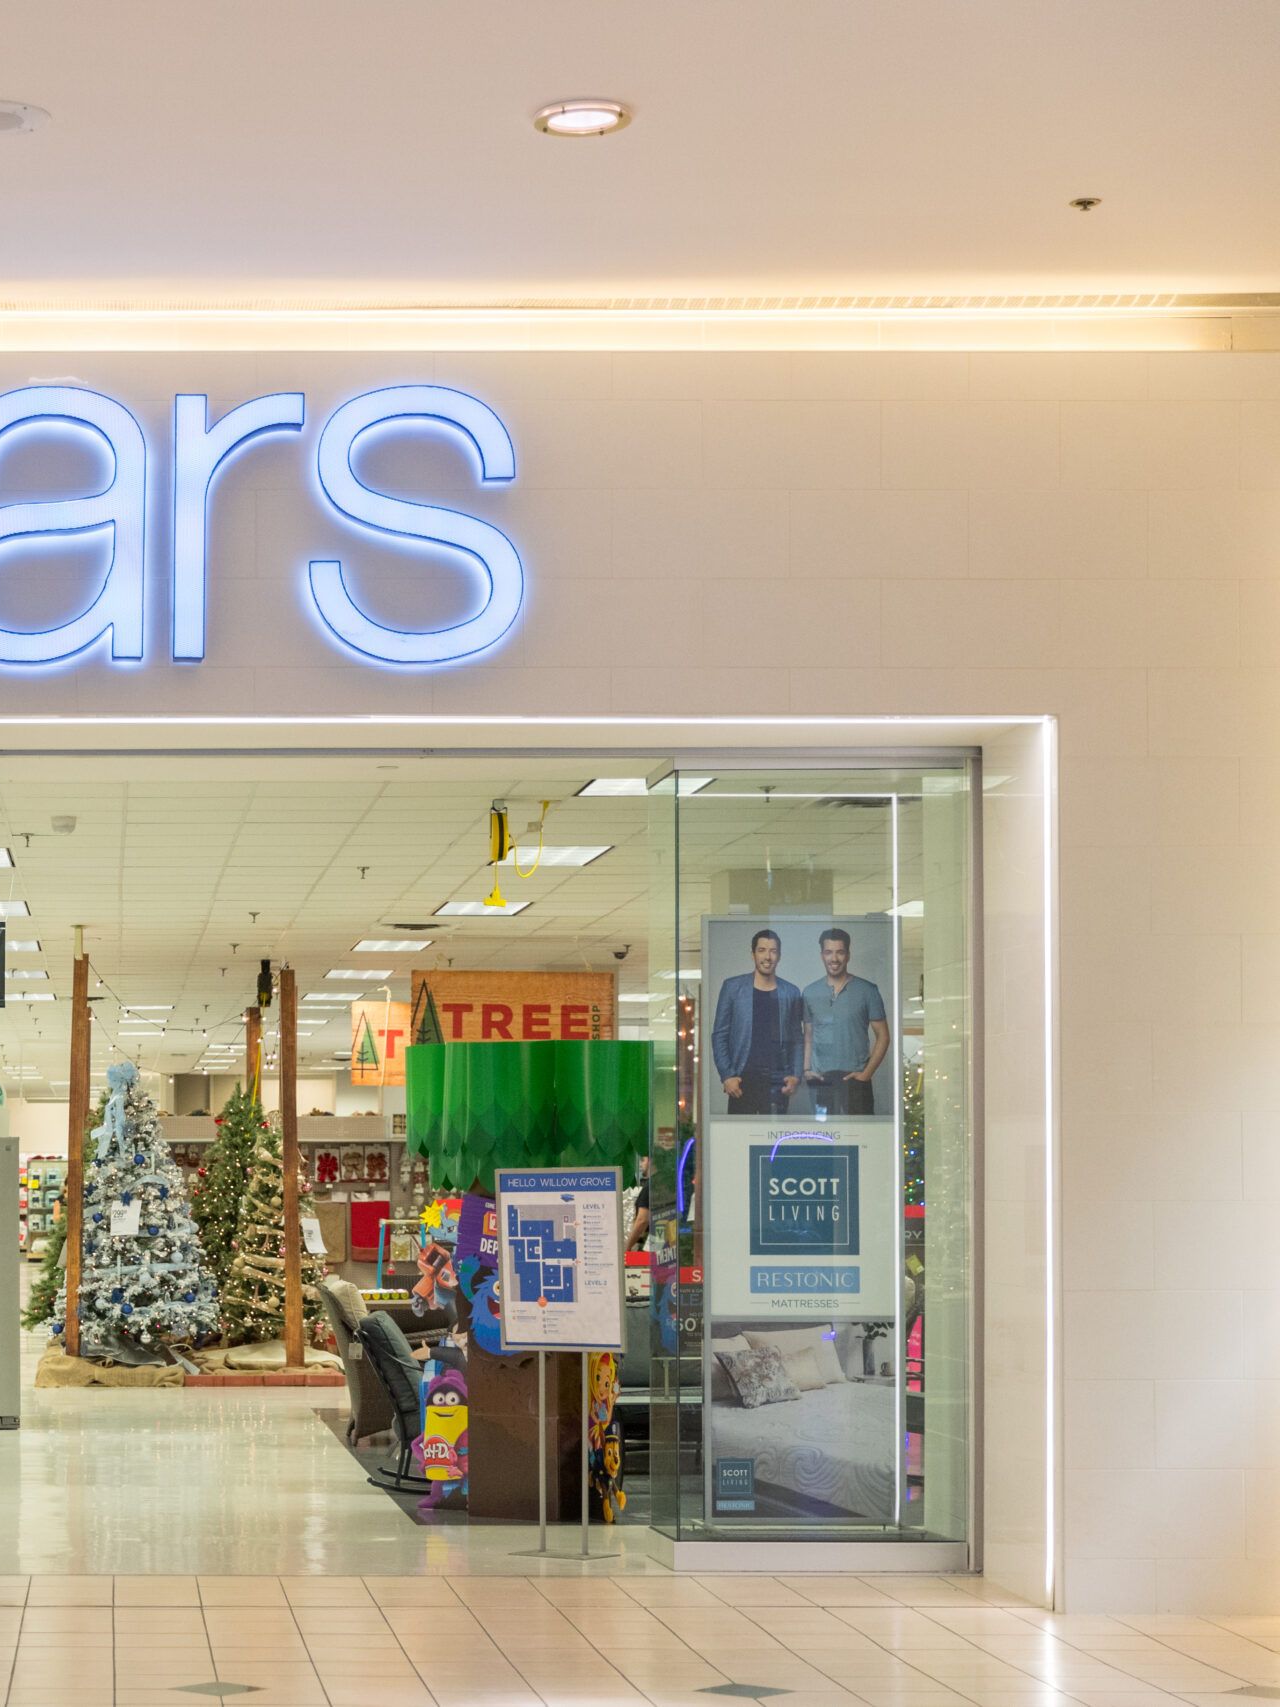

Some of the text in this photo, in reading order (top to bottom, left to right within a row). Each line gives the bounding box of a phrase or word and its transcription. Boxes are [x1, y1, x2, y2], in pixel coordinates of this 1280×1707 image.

[442, 1004, 590, 1040] TREE
[592, 1005, 601, 1040] SHOP
[767, 1131, 841, 1140] INTRODUCING
[507, 1177, 611, 1188] HELLO WILLOW GROVE
[769, 1178, 840, 1195] SCOTT
[769, 1206, 841, 1221] LIVING
[584, 1279, 600, 1287] LEVEL
[757, 1272, 854, 1288] RESTONIC
[771, 1300, 839, 1308] MATTRESSES
[722, 1469, 748, 1477] SCOTT
